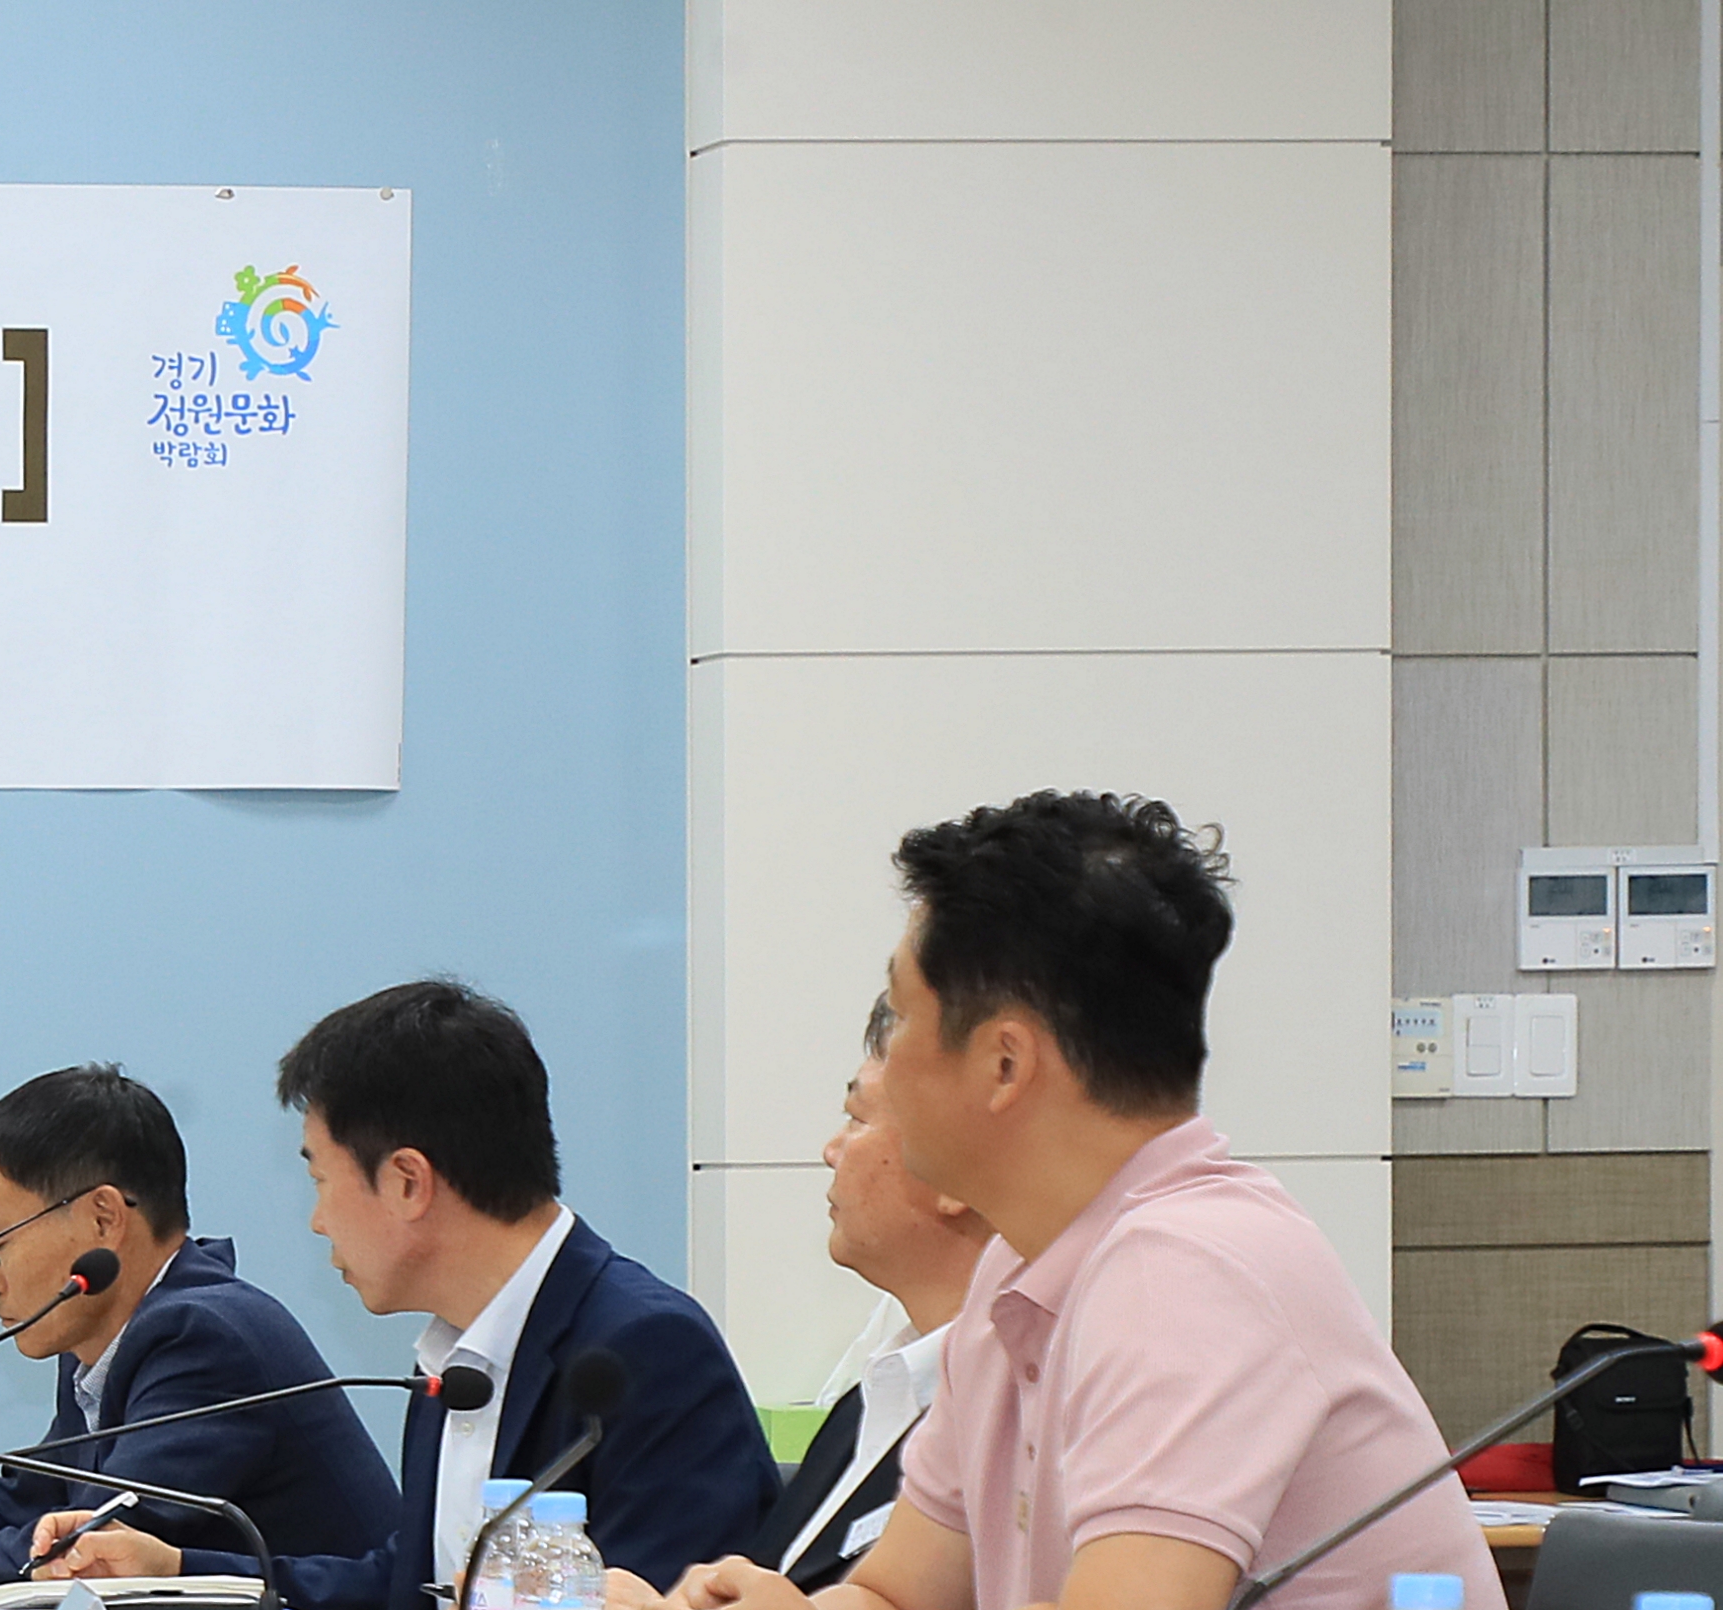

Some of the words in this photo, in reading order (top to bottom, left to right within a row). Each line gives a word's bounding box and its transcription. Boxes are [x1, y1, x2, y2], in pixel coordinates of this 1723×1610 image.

[151, 351, 217, 391] 경기
[147, 393, 297, 438] 정원문화
[152, 441, 228, 469] 박람회
